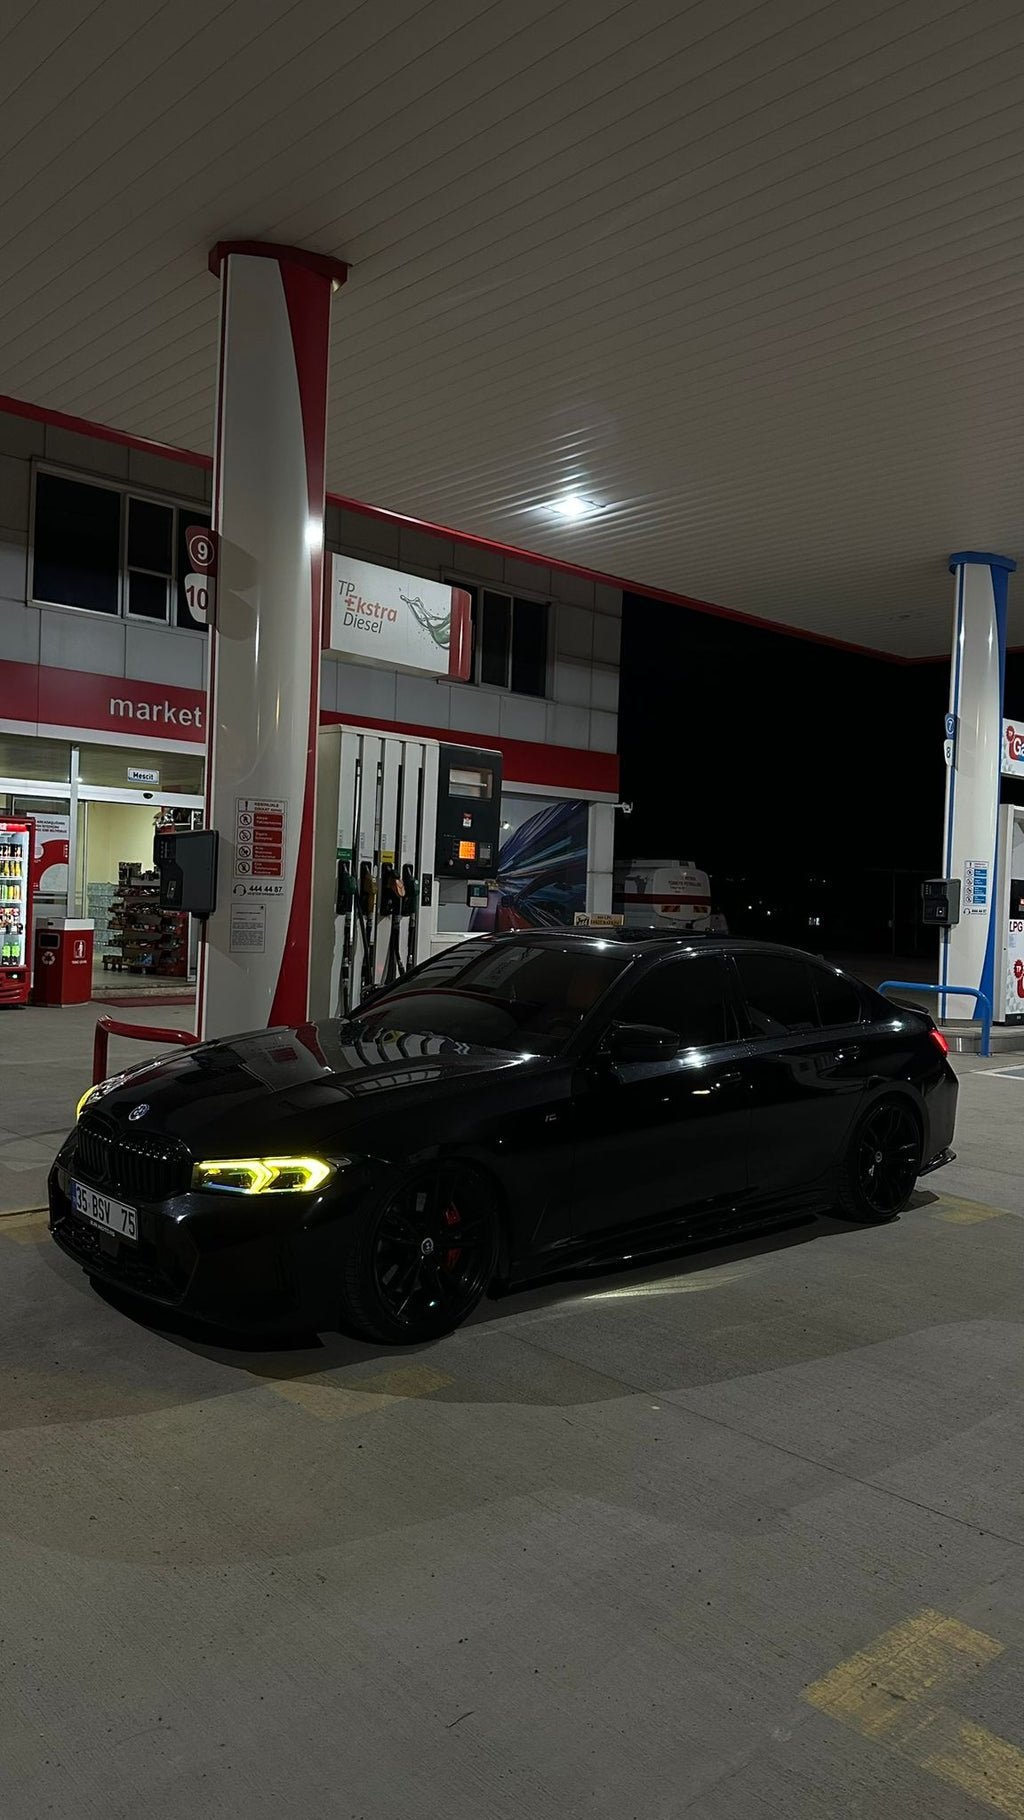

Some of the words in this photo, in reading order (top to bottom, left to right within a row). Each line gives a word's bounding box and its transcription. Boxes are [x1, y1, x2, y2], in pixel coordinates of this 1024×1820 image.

[197, 542, 209, 561] 9
[186, 585, 209, 610] 10
[338, 579, 355, 597] TP
[344, 594, 398, 623] Ekstra
[343, 611, 383, 634] Diesel
[109, 697, 203, 728] market
[946, 746, 951, 759] 8
[132, 771, 154, 781] Mescit
[1009, 921, 1023, 932] LPG
[77, 1186, 88, 1212] 35
[121, 1208, 136, 1236] 75
